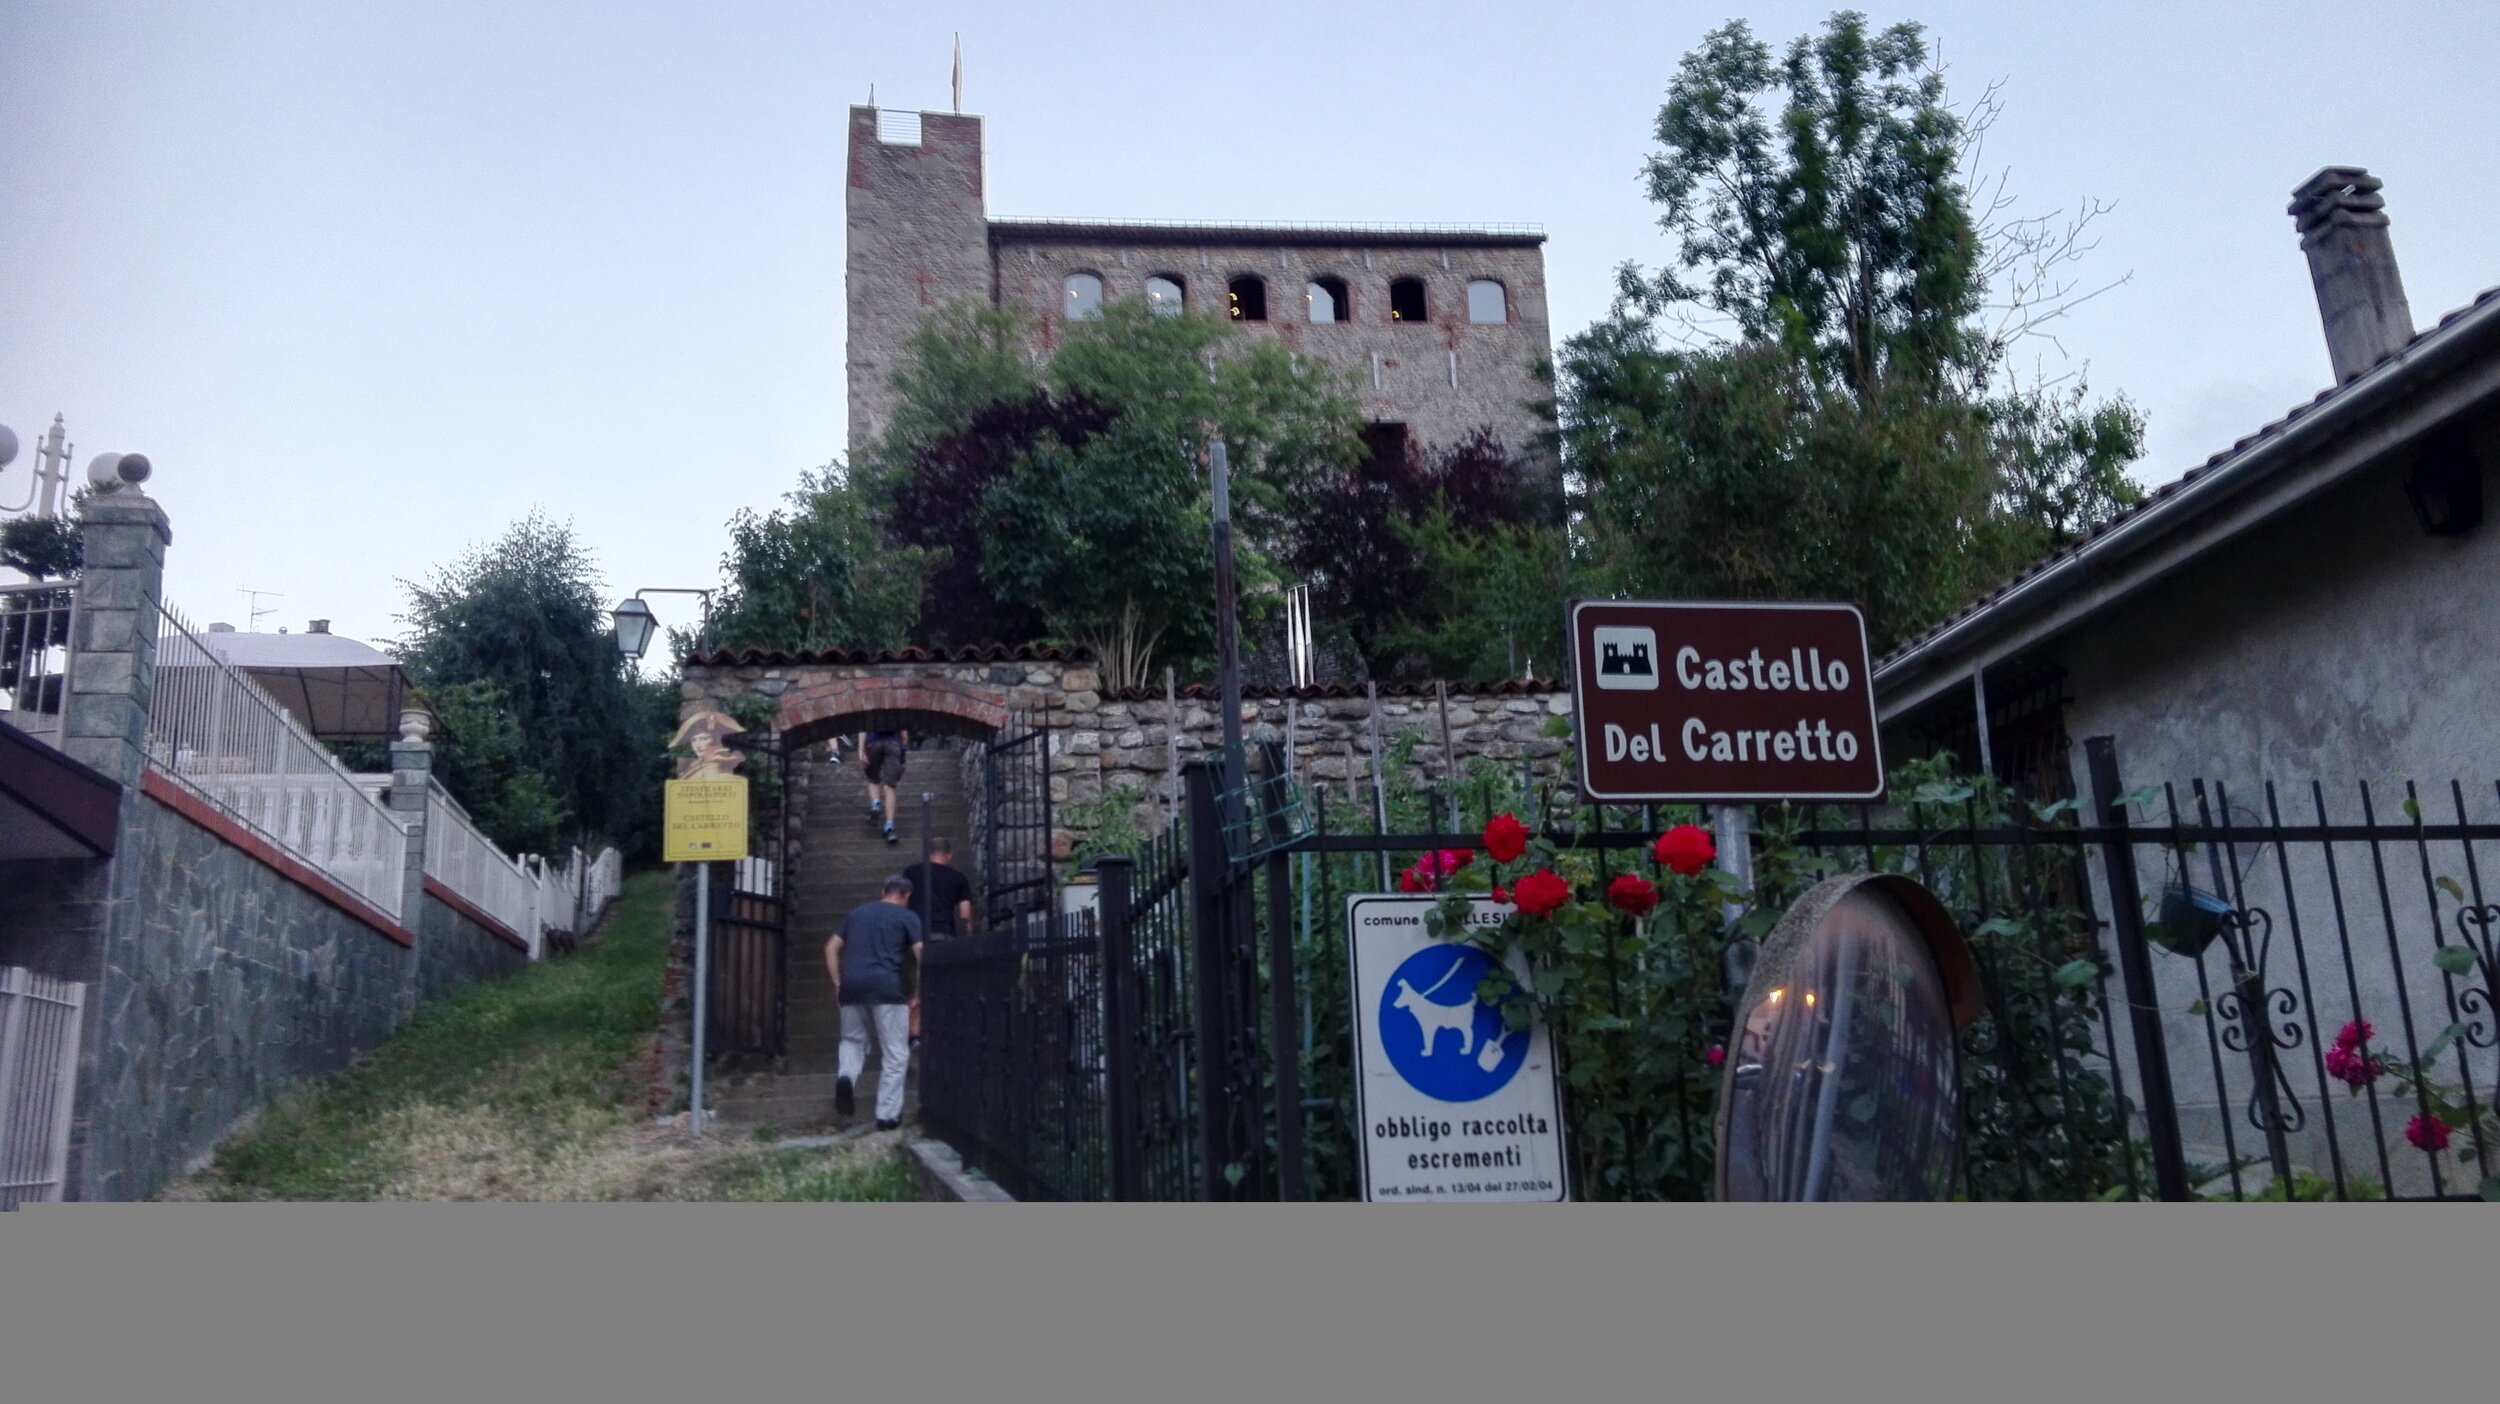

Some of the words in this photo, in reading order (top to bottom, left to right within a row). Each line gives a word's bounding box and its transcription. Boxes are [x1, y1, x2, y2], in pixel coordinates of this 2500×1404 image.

[1676, 645, 1850, 691] Castello
[1604, 723, 1667, 762] Del
[1681, 717, 1858, 762] Carretto
[1363, 916, 1420, 926] comune
[1375, 1114, 1452, 1142] obbligo
[1462, 1113, 1549, 1137] raccolta
[1407, 1145, 1522, 1169] escrementi
[1378, 1185, 1402, 1196] ord.
[1405, 1184, 1434, 1195] sind.
[1451, 1182, 1481, 1194] 13/04
[1484, 1181, 1503, 1193] del
